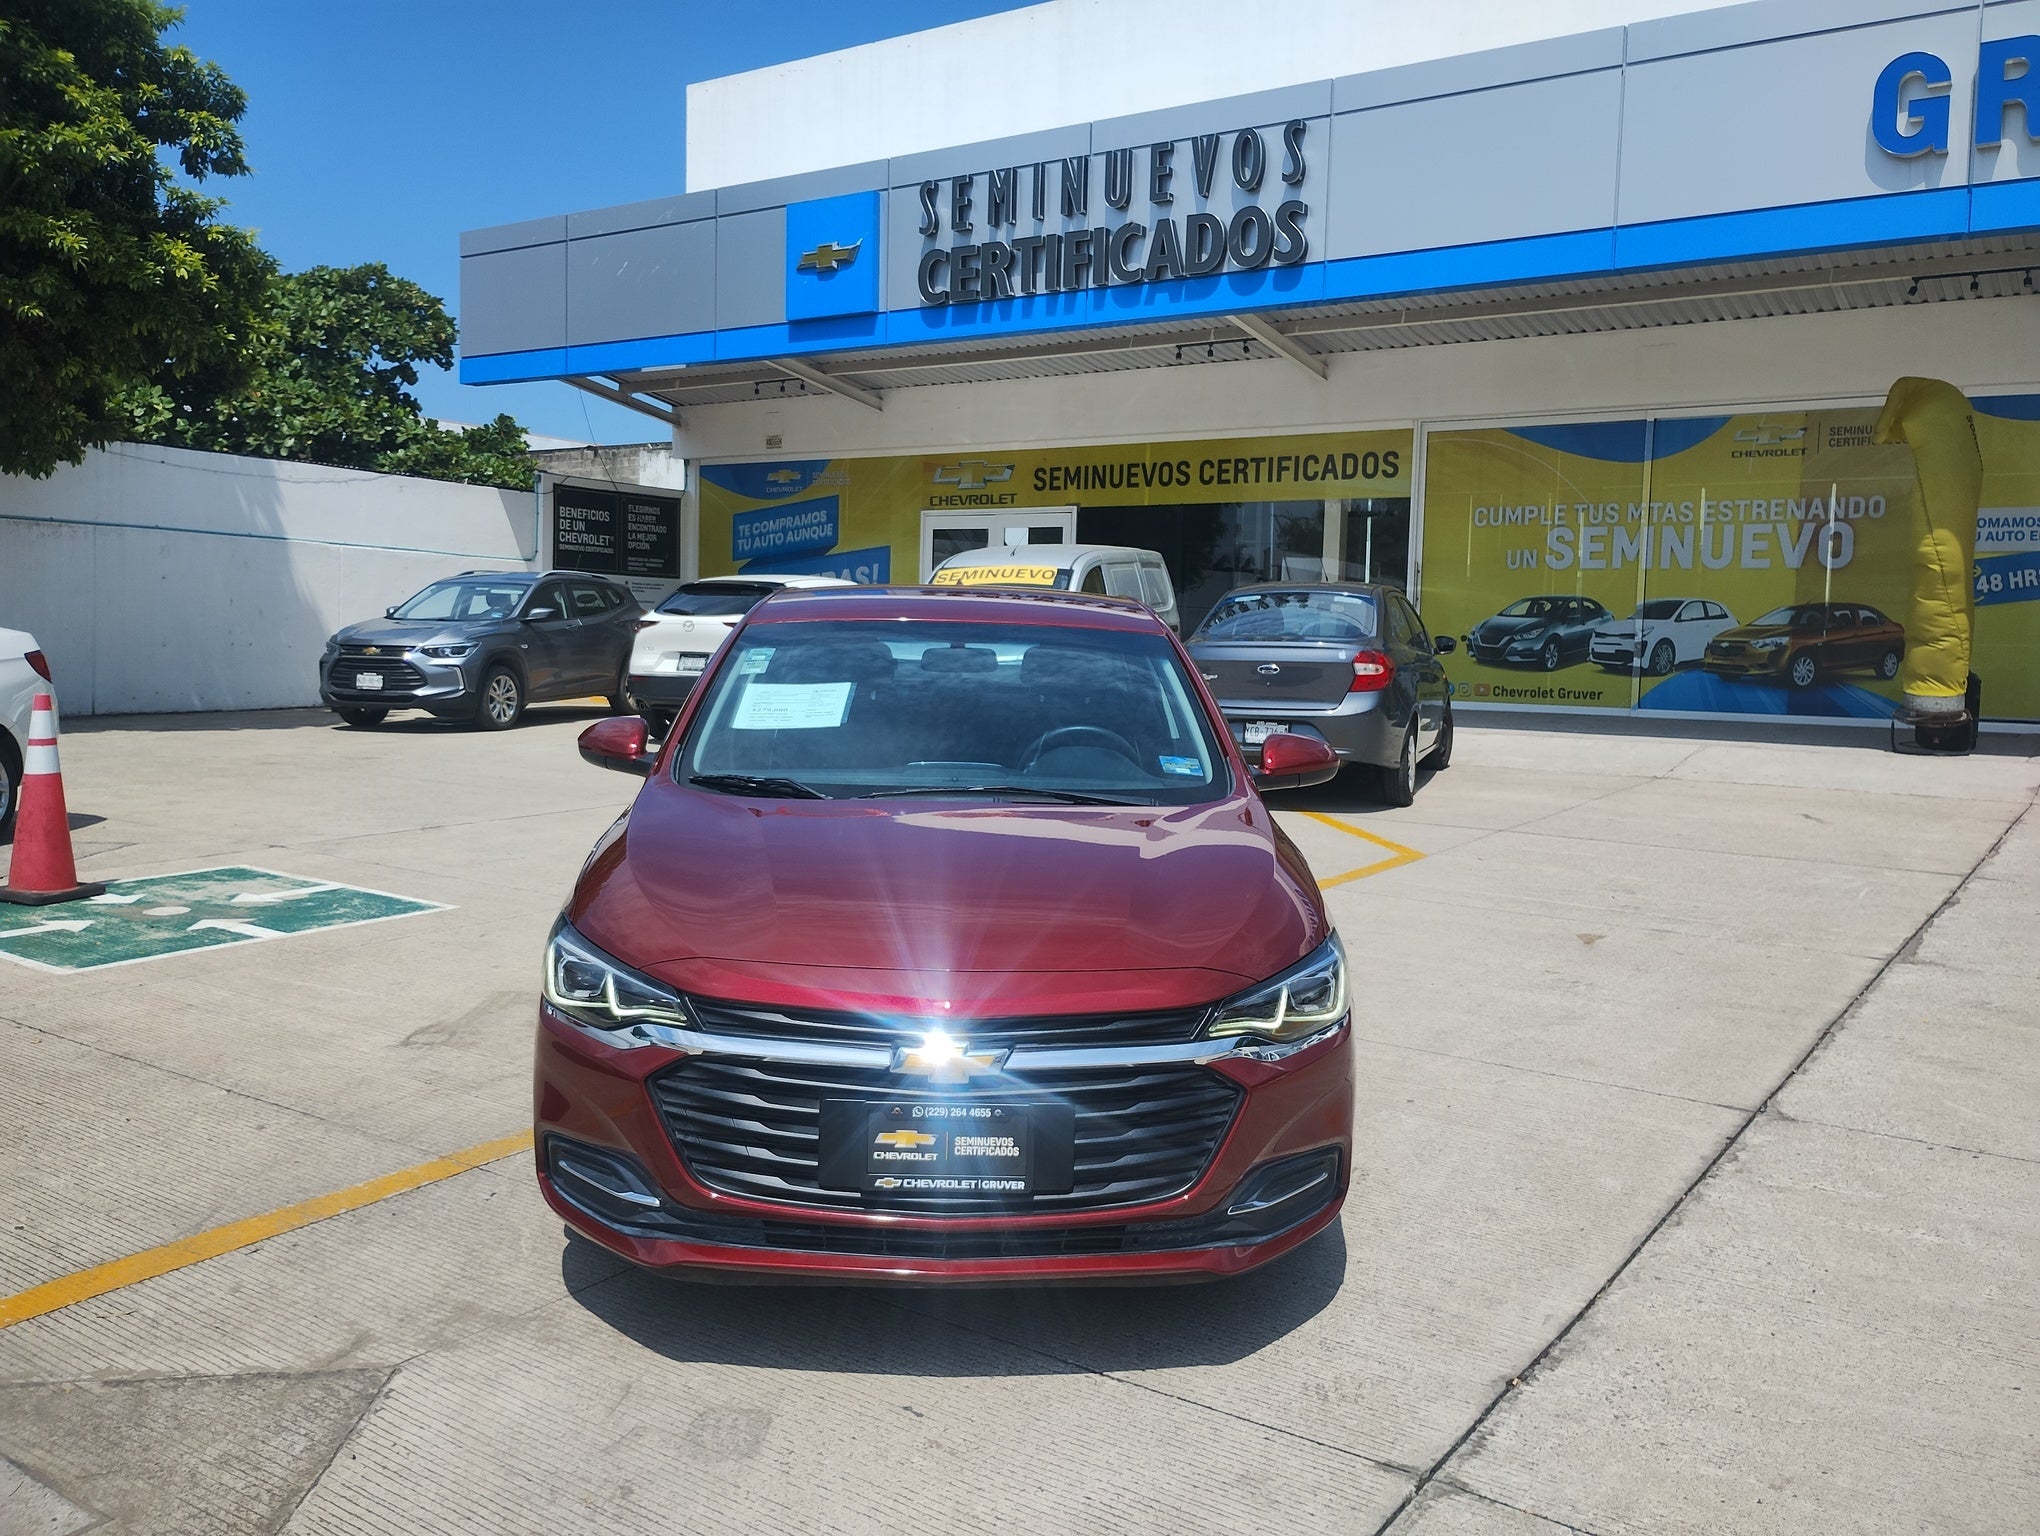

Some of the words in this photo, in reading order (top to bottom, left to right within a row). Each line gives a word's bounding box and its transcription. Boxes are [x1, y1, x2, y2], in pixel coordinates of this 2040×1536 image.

[919, 119, 1306, 236] SEMINUEVOS
[918, 199, 1308, 305] CERTIFICADOS
[1828, 425, 1873, 437] SEMINU
[1731, 448, 1808, 458] CHEVROLET
[1033, 460, 1191, 492] SEMINUEVOS
[1199, 450, 1400, 485] CERTIFICADOS
[929, 493, 1017, 506] CHEVROLET
[559, 505, 611, 522] BENEFICIOS
[628, 513, 637, 522] ES
[1474, 504, 1566, 527] CUMPLE
[1573, 503, 1619, 525] TUS
[1627, 501, 1694, 523] MTAS
[1703, 495, 1886, 522] ESTRENANDO
[559, 519, 571, 530] DE
[573, 520, 586, 532] UN
[738, 524, 751, 537] TE
[751, 510, 828, 534] COMPRAMOS
[559, 531, 610, 546] CHEVROLET
[628, 532, 637, 541] LA
[737, 538, 752, 551] TU
[753, 532, 784, 550] AUTO
[785, 523, 834, 544] AUNQUE
[1985, 530, 2026, 542] AUTO
[1506, 549, 1538, 569] UN
[936, 568, 1056, 584] SEMINUEVO
[1976, 572, 2004, 594] 48
[2008, 569, 2040, 590] HR
[1492, 685, 1554, 699] Chevrolet
[1557, 687, 1604, 701] Gruver
[925, 1107, 949, 1119] (229)
[950, 1108, 967, 1118] 264
[969, 1108, 992, 1118] 4655
[954, 1136, 1014, 1147] SEMINUEVOS
[873, 1151, 938, 1161] CHEVROLET
[954, 1145, 1020, 1157] CERTIFICADOS
[902, 1178, 978, 1189] CHEVROLET
[982, 1180, 1025, 1190] GRUVER
